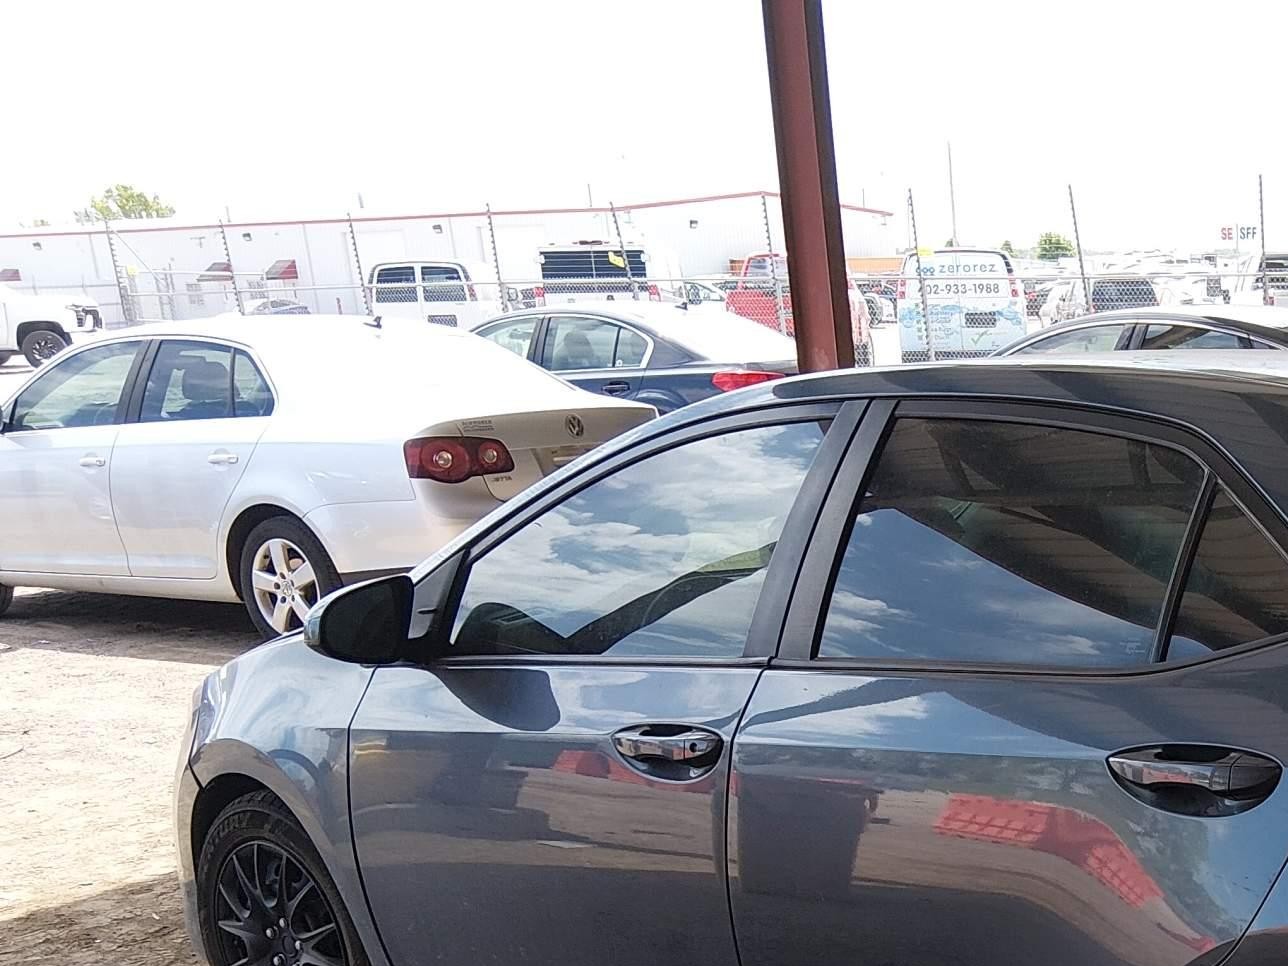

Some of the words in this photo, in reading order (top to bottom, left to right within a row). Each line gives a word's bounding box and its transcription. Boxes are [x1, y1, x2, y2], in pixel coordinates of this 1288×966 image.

[1220, 227, 1233, 241] SE
[939, 263, 997, 275] zerorez
[922, 283, 1000, 296] 02-933-1988
